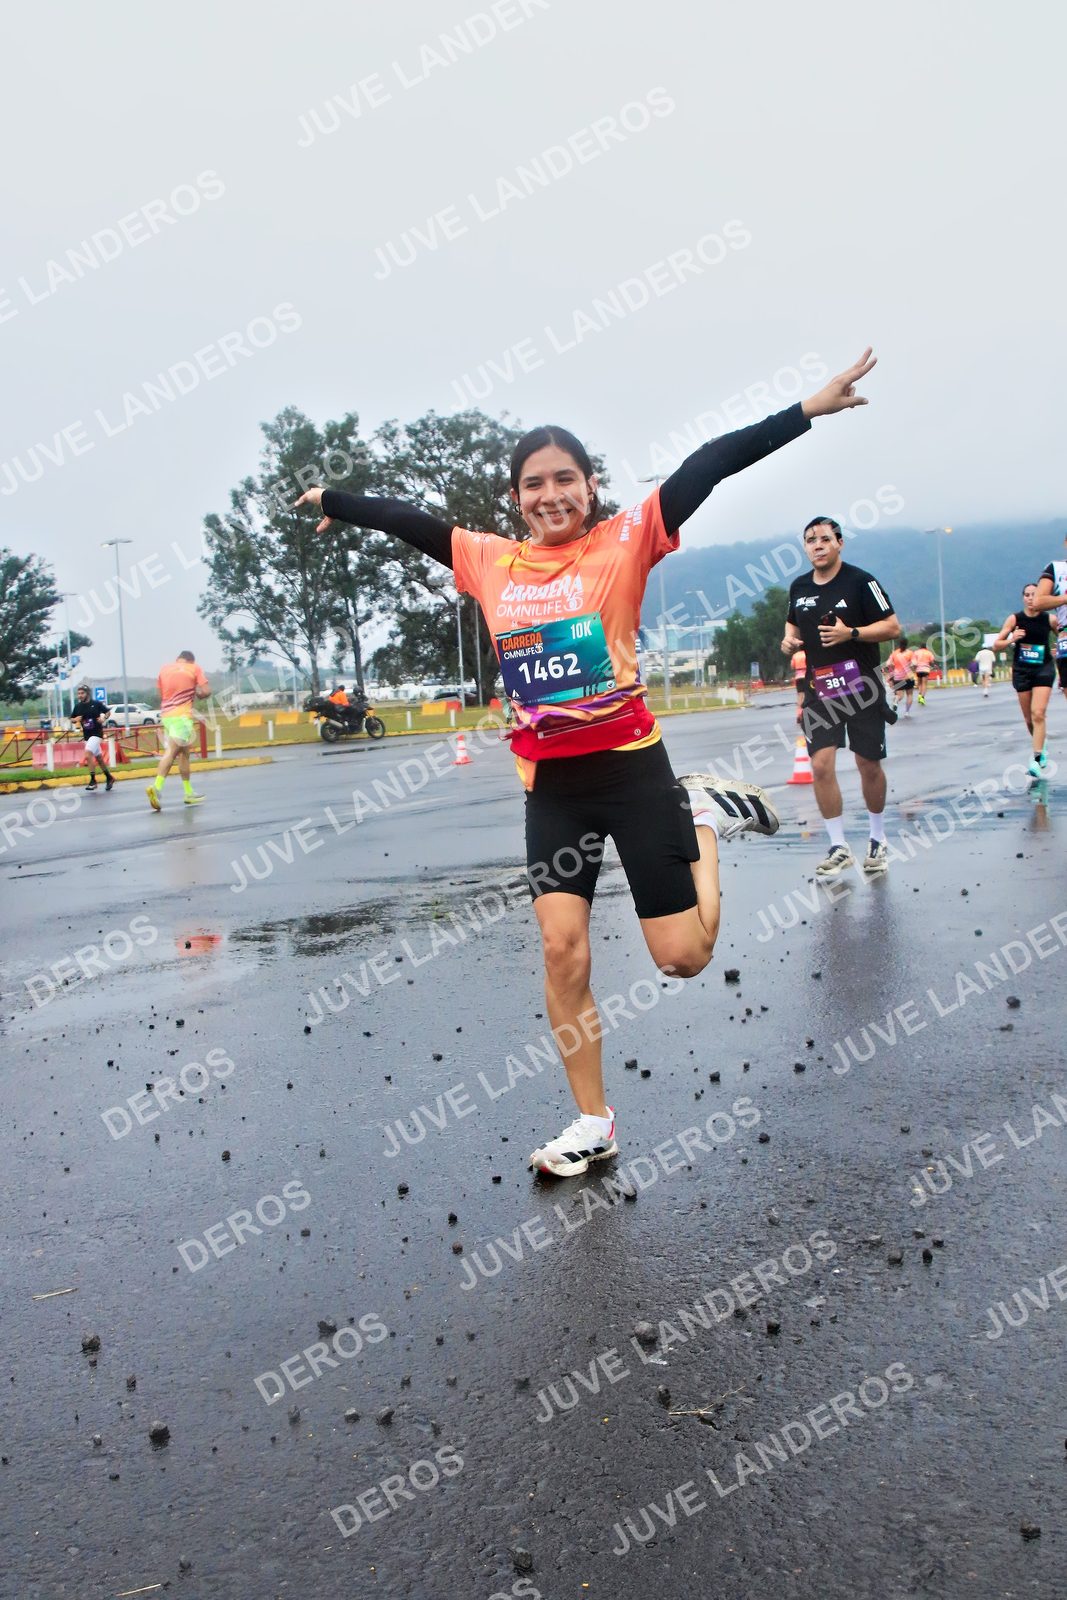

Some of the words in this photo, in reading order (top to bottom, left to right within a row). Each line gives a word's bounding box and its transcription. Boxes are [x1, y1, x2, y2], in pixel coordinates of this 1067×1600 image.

[501, 571, 584, 601] CARRERA
[570, 620, 593, 640] 10K
[501, 632, 543, 651] CARRERA
[518, 653, 582, 684] 1462
[825, 676, 846, 689] 381
